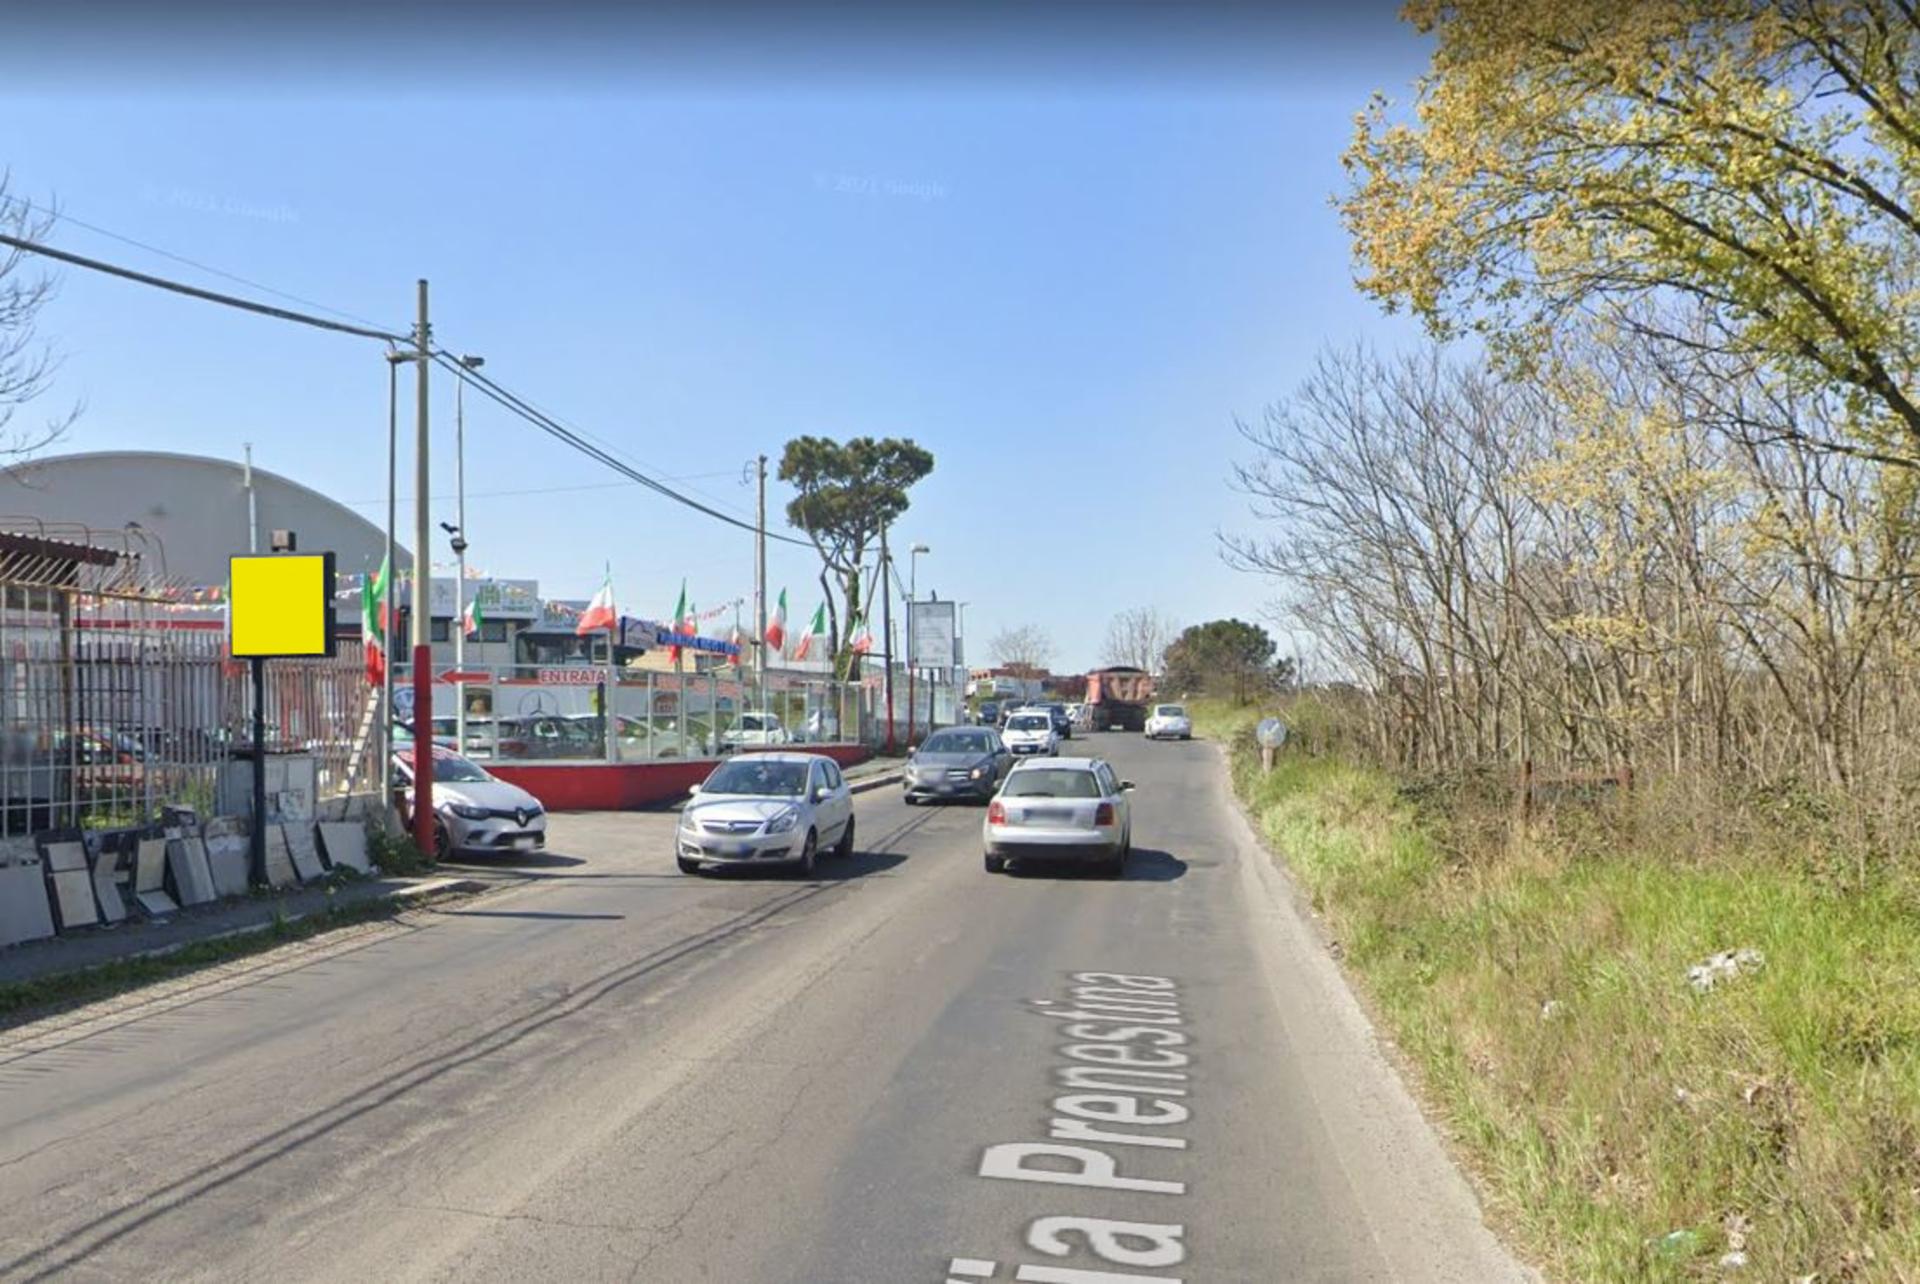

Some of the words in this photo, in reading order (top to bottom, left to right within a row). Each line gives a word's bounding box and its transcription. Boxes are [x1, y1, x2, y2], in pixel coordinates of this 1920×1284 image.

[540, 669, 606, 682] ENTRATA
[979, 972, 1188, 1194] Prenestina
[946, 1216, 1185, 1284] ia
